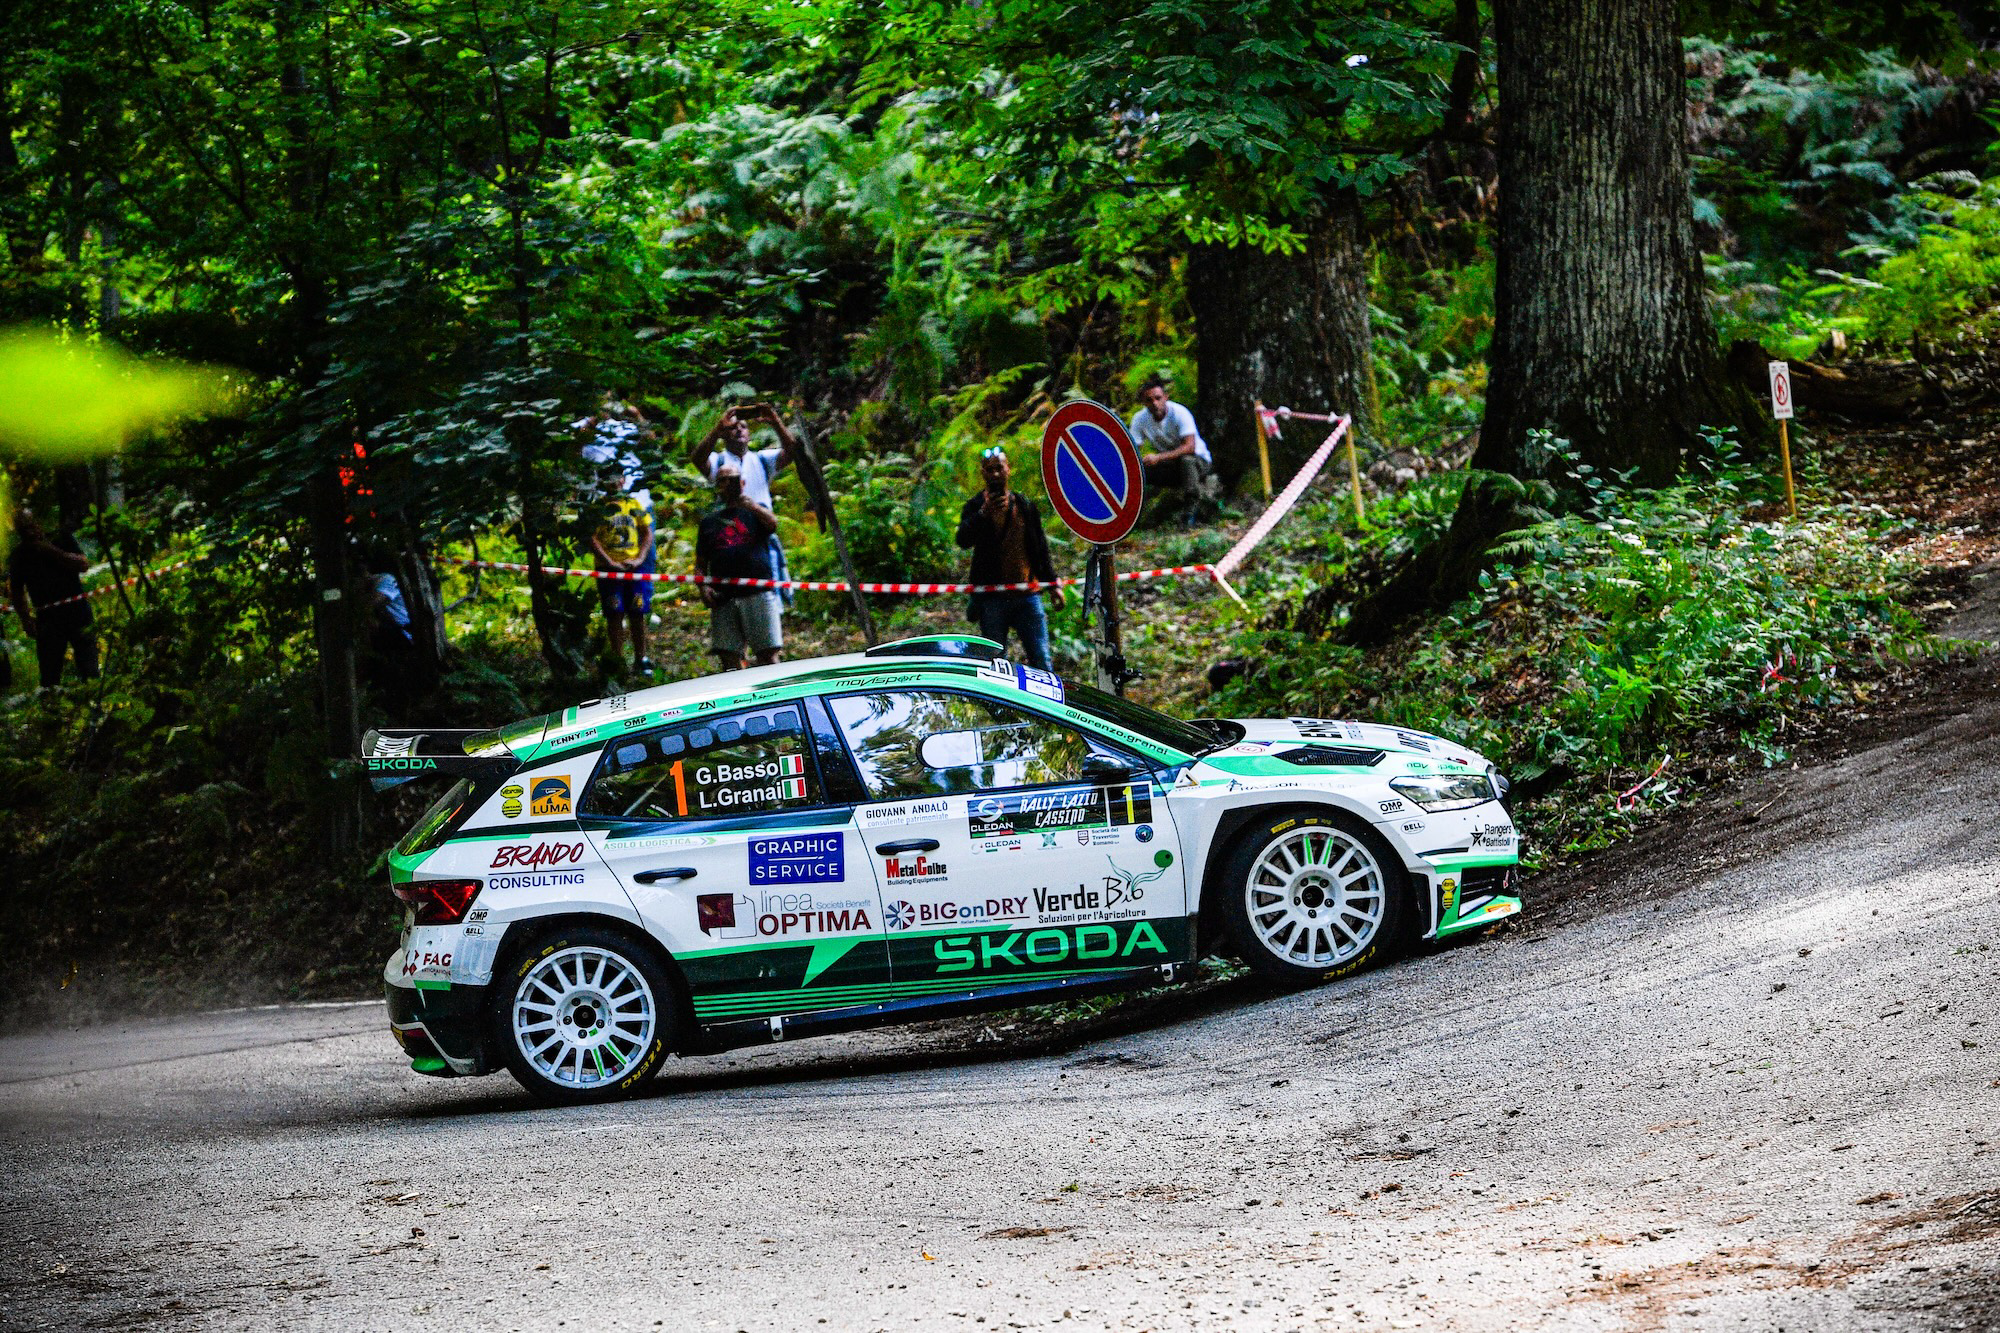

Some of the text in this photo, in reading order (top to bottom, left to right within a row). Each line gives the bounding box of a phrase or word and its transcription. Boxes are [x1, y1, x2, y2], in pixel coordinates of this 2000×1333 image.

[624, 717, 647, 727] OMP
[550, 732, 581, 747] PENNY
[1065, 709, 1169, 755] @lorenzo.granai
[696, 762, 779, 785] G.Basso
[669, 760, 689, 816] 1
[699, 782, 782, 809] L.Granai
[533, 803, 570, 814] LUMA
[911, 800, 948, 815] ANDALÒ
[1019, 792, 1099, 814] RALLY LAZIO
[1122, 785, 1135, 824] 1
[1380, 800, 1403, 812] OMP
[867, 812, 949, 827] consulente patrimoniale
[1034, 808, 1086, 828] CASSINO
[970, 822, 1014, 833] CLEDAN
[1403, 823, 1424, 831] BELL
[1484, 823, 1512, 837] Rangers
[603, 837, 691, 850] ASOLO LOGISTICA
[755, 838, 838, 855] GRAPHIC
[985, 839, 1021, 848] CLEDAN
[490, 842, 585, 871] BRANDO
[756, 862, 839, 879] SERVICE
[886, 856, 947, 878] MetalColbe
[489, 874, 585, 890] CONSULTING
[887, 876, 948, 886] Building Equipments
[760, 890, 871, 912] linea Società Benefit
[1033, 875, 1144, 913] Verde Bio
[469, 911, 488, 920] OMP
[919, 896, 1028, 921] BIGonDRY
[1038, 909, 1146, 924] Soluzioni per l'Agricoltura
[758, 909, 872, 936] OPTIMA
[423, 952, 452, 966] FAG
